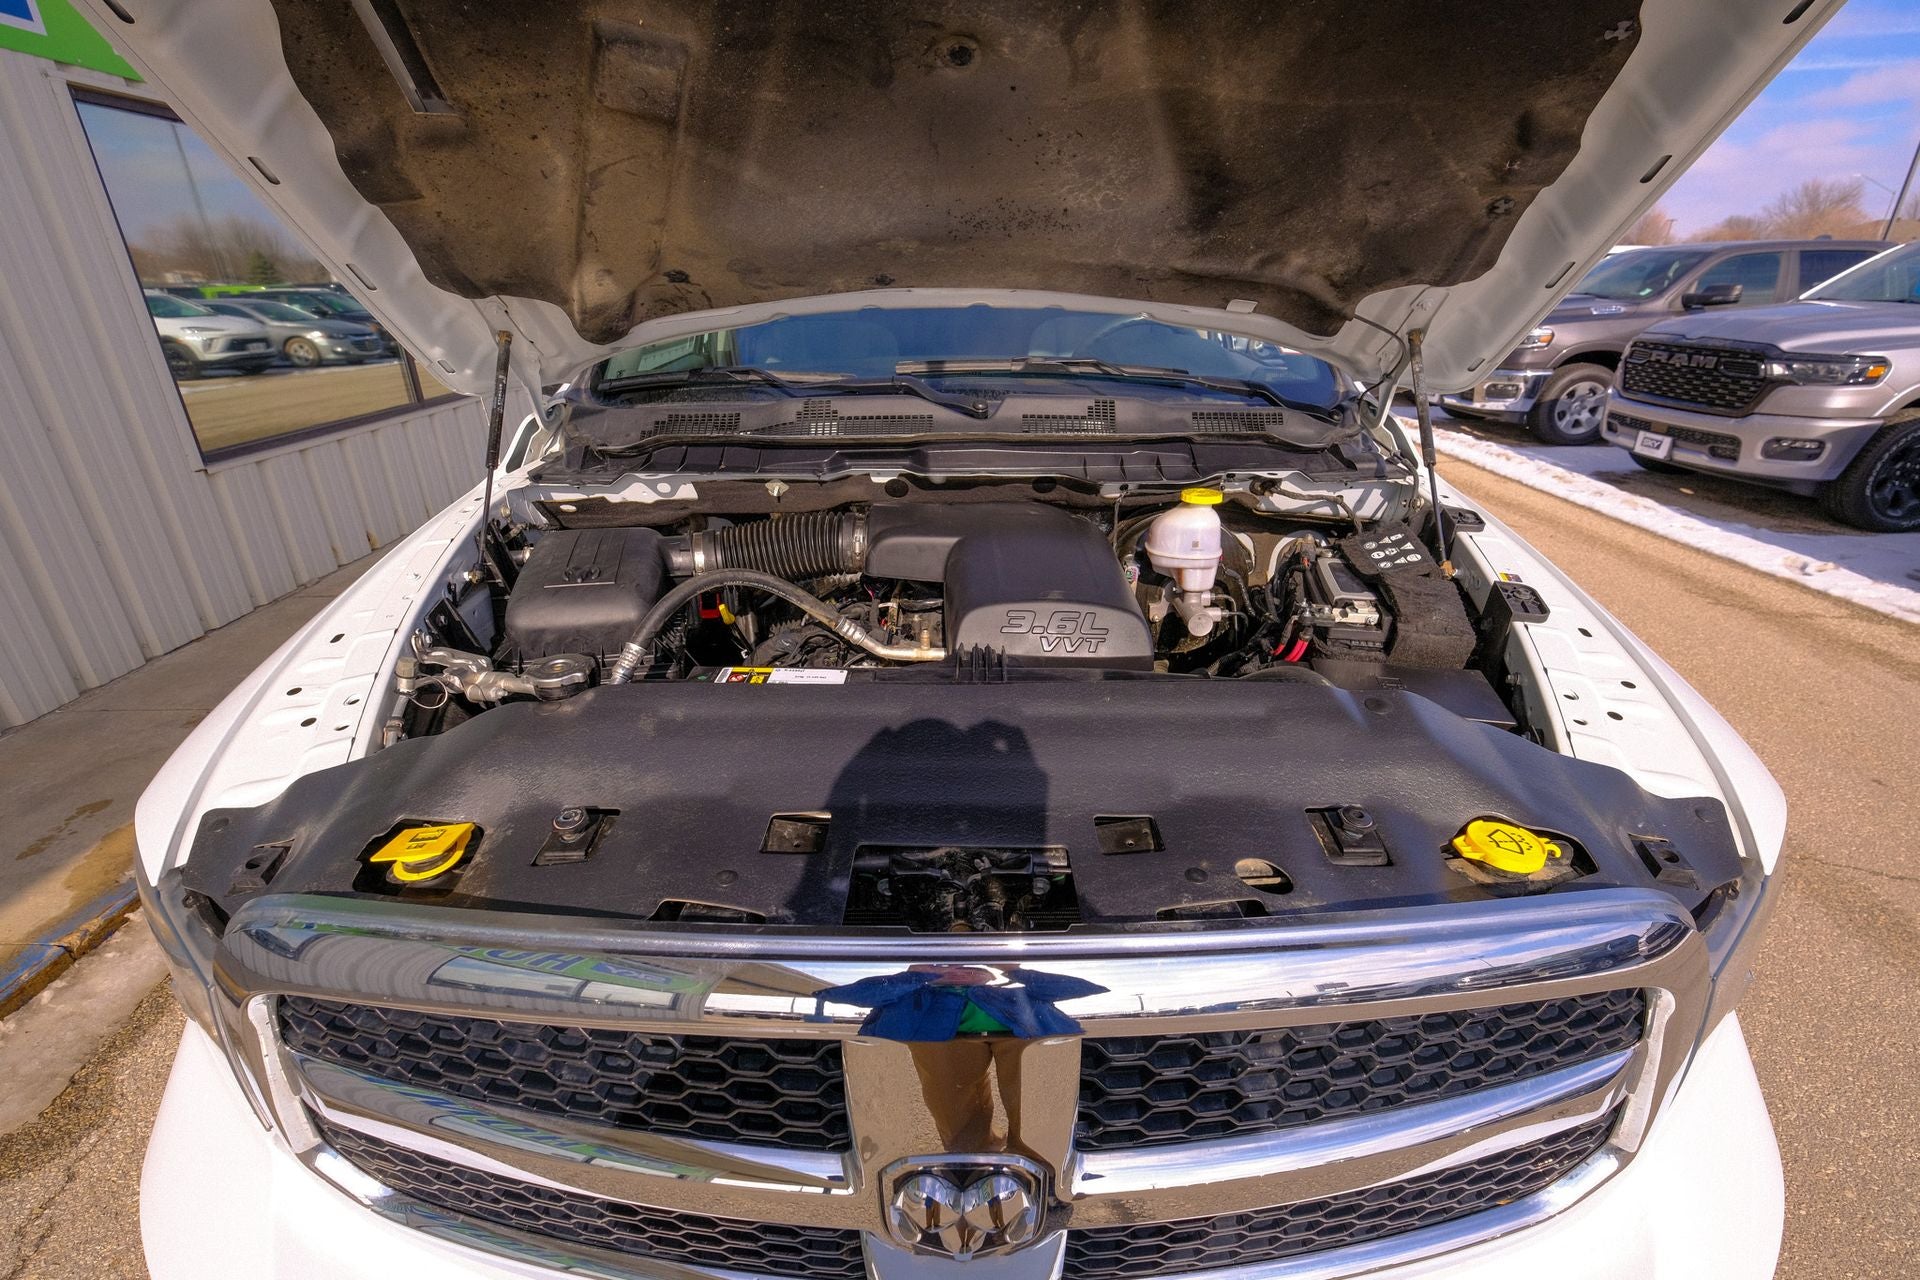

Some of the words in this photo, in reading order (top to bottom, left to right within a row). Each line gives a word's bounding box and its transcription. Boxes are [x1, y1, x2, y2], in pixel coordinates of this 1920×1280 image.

[1649, 351, 1718, 369] RAM
[1000, 610, 1109, 636] 3.6L
[1040, 636, 1106, 653] VVT
